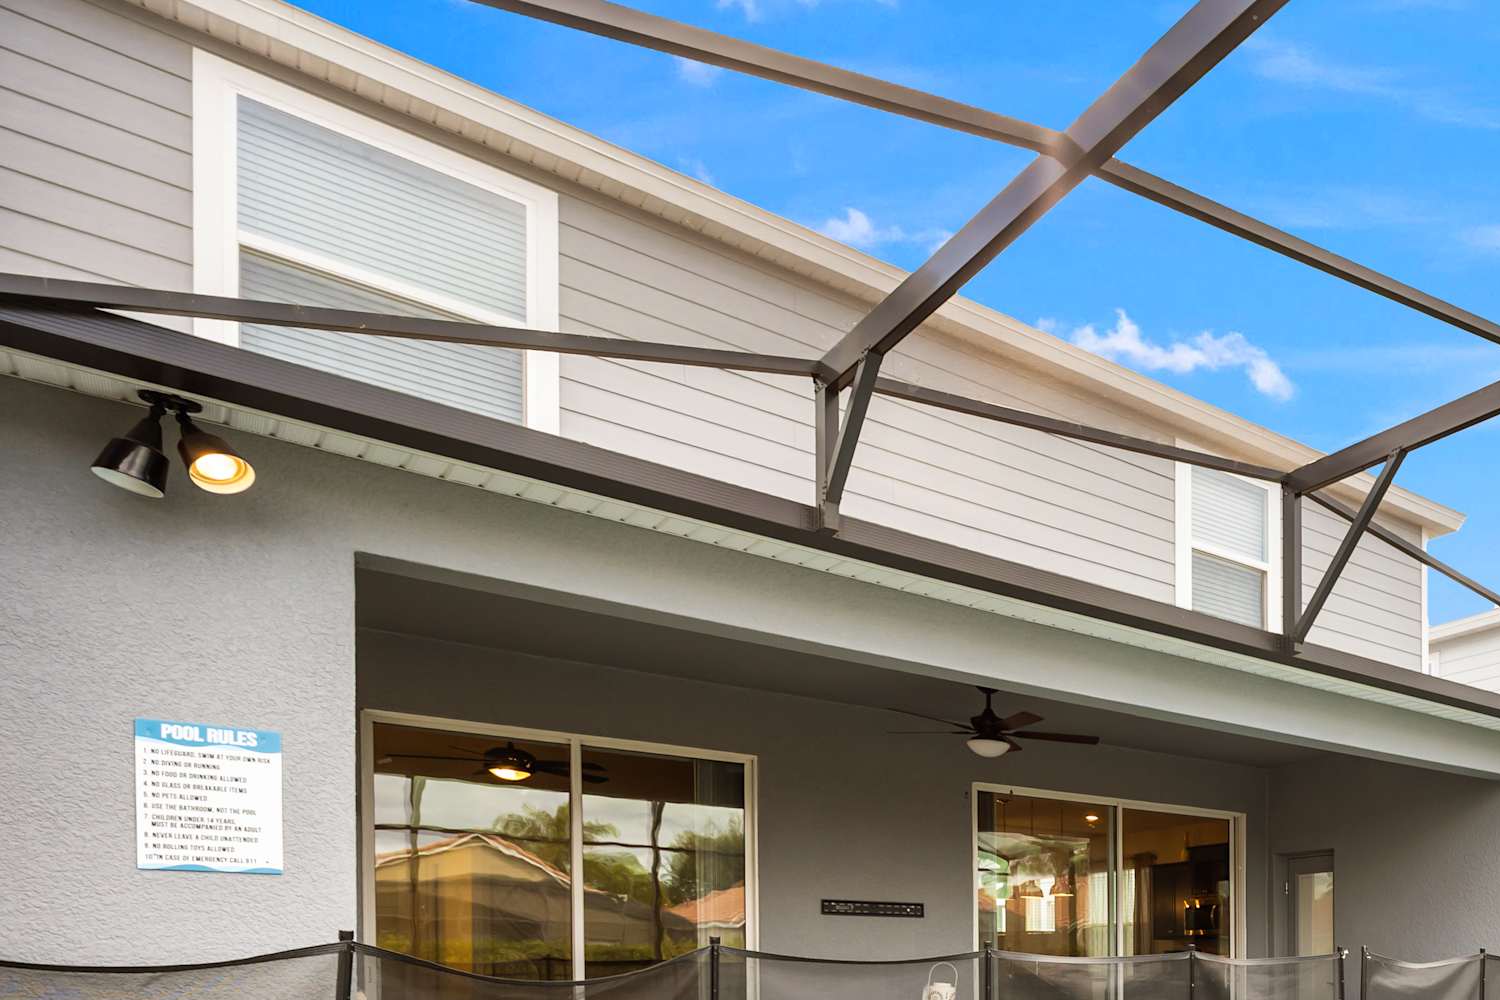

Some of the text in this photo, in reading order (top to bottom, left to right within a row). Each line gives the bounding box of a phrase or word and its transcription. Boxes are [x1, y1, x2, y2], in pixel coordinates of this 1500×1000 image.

[160, 723, 258, 747] POOL RULES
[189, 773, 217, 781] DRINKING
[220, 775, 247, 783] ALLOWED
[192, 784, 227, 792] BREAKABLE
[229, 786, 247, 794] ITEMS
[180, 823, 223, 831] ACCOMPANIED
[220, 835, 259, 843] UNATTENDED
